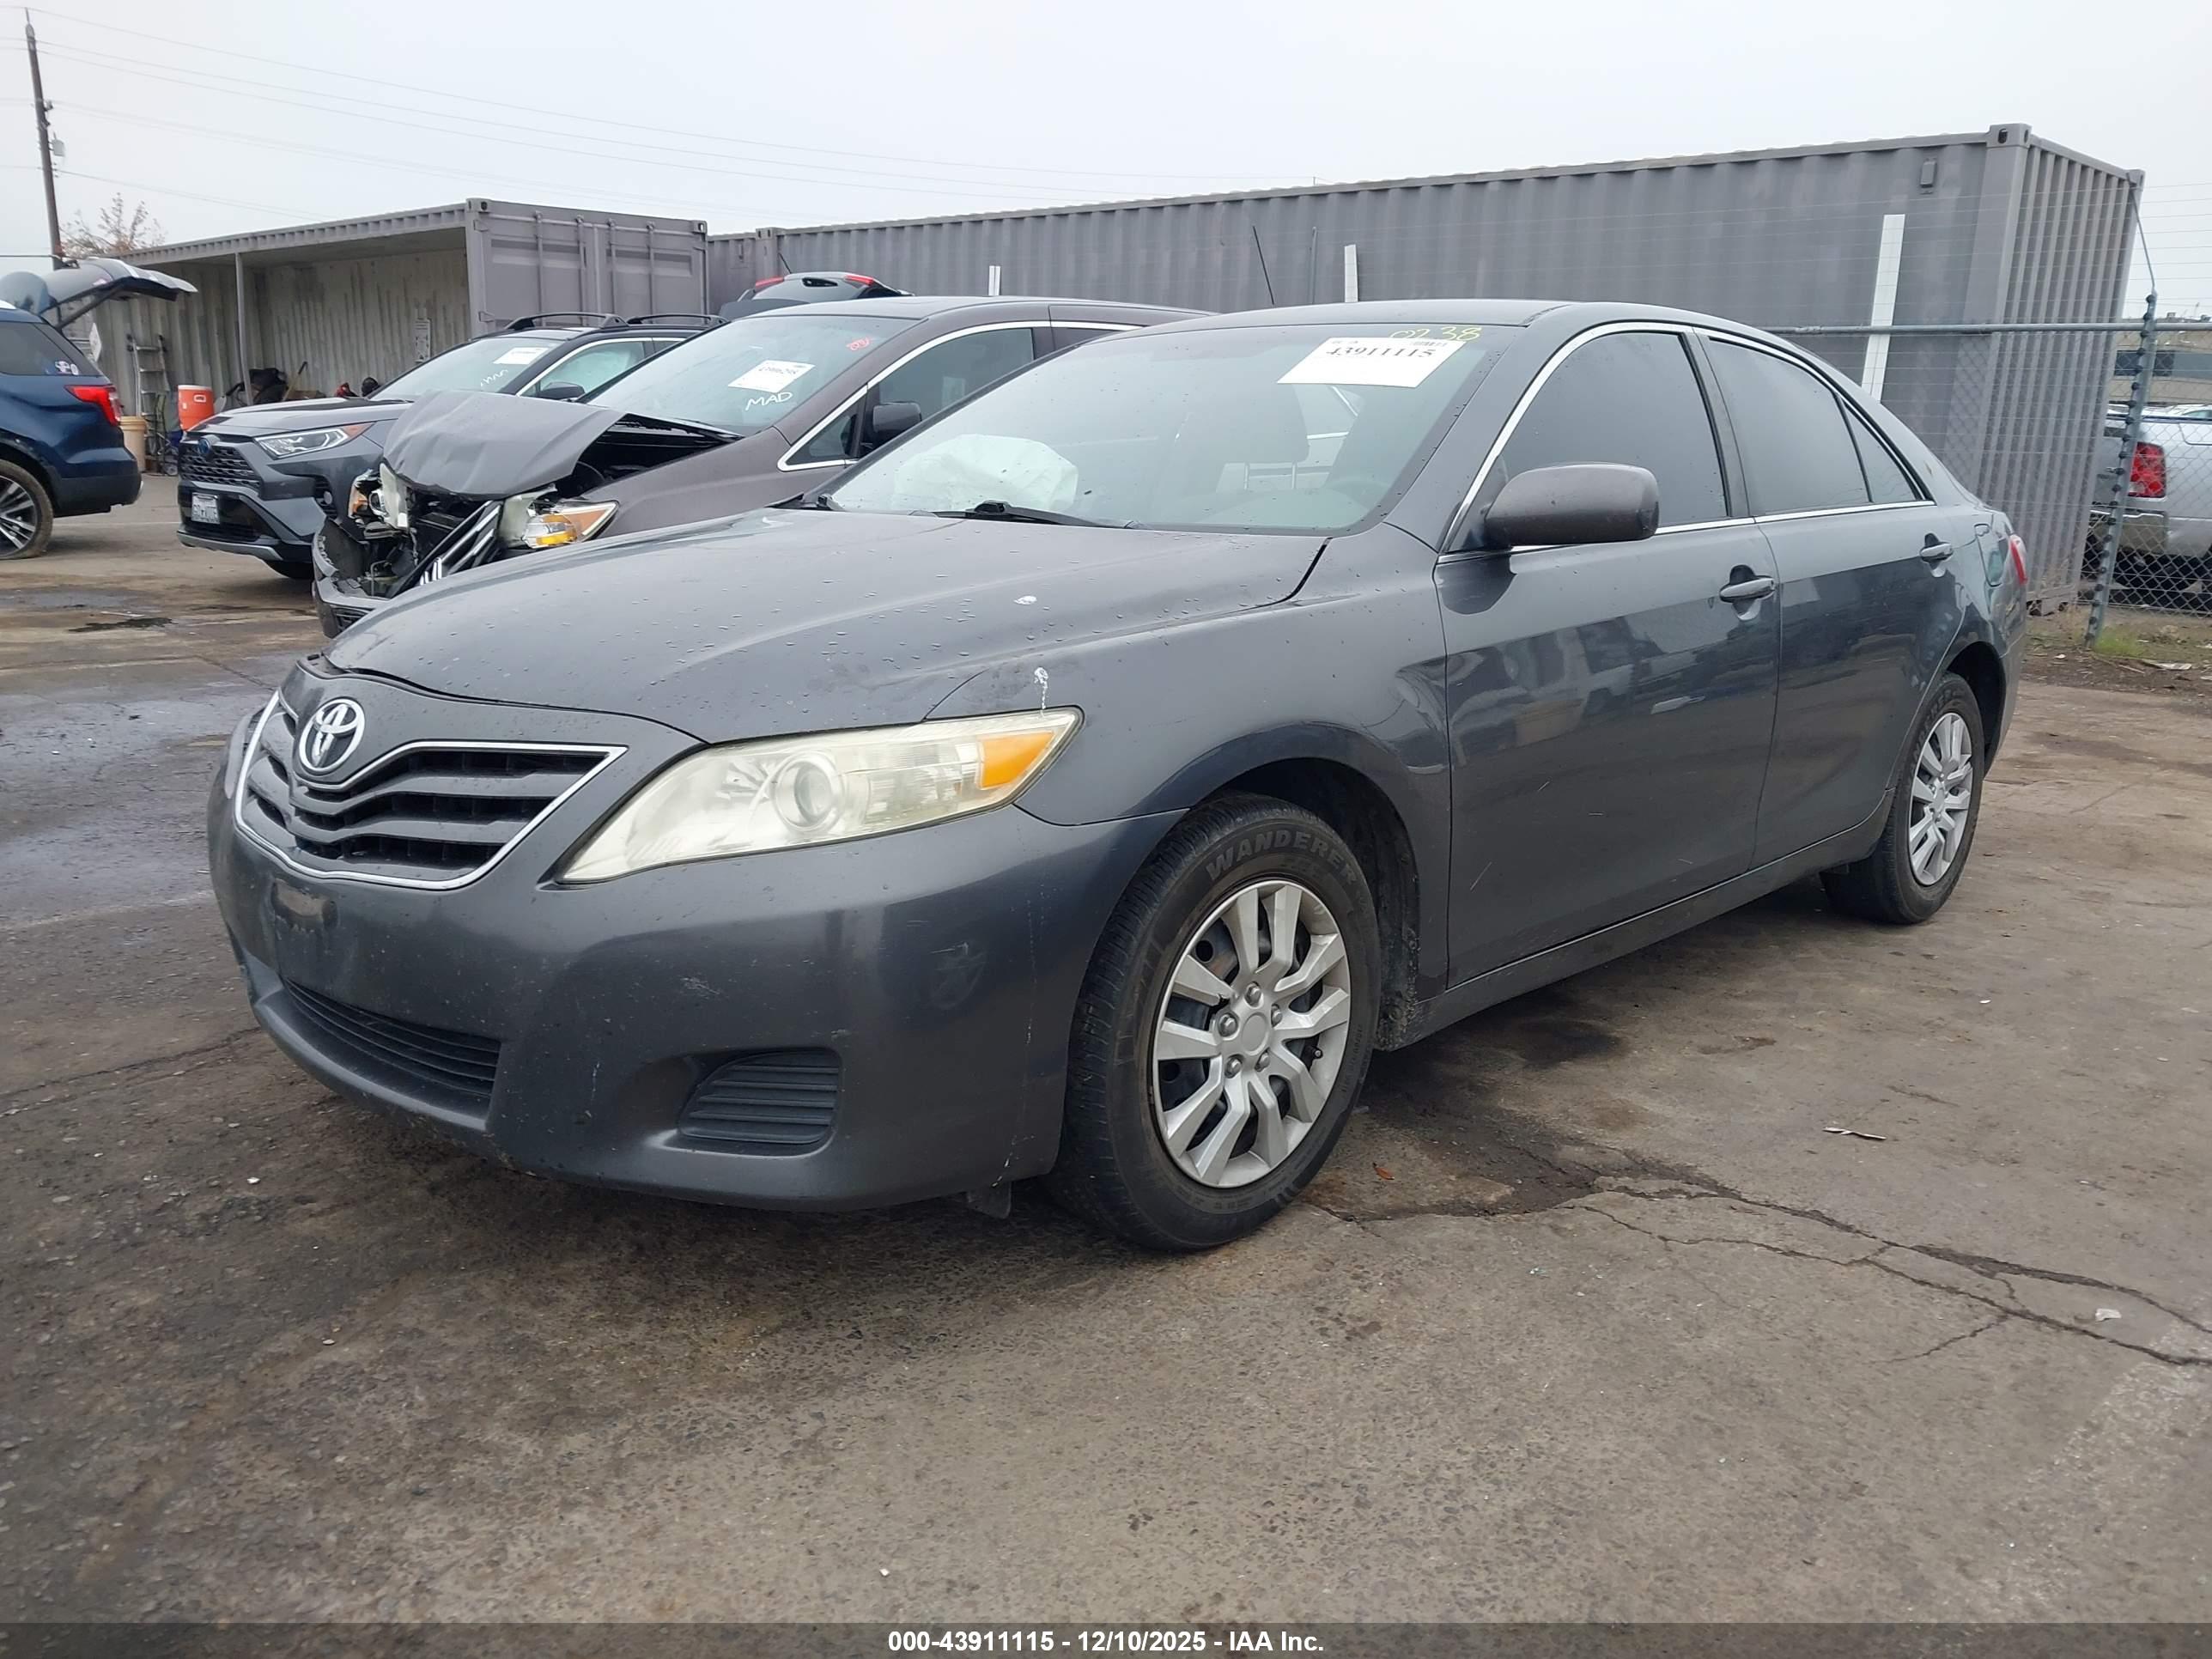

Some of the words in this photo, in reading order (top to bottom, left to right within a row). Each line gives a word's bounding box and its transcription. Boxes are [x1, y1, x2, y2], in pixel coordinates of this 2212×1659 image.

[1326, 346, 1437, 359] 43911115
[744, 391, 793, 411] MAD
[1204, 829, 1360, 885] WANDERER
